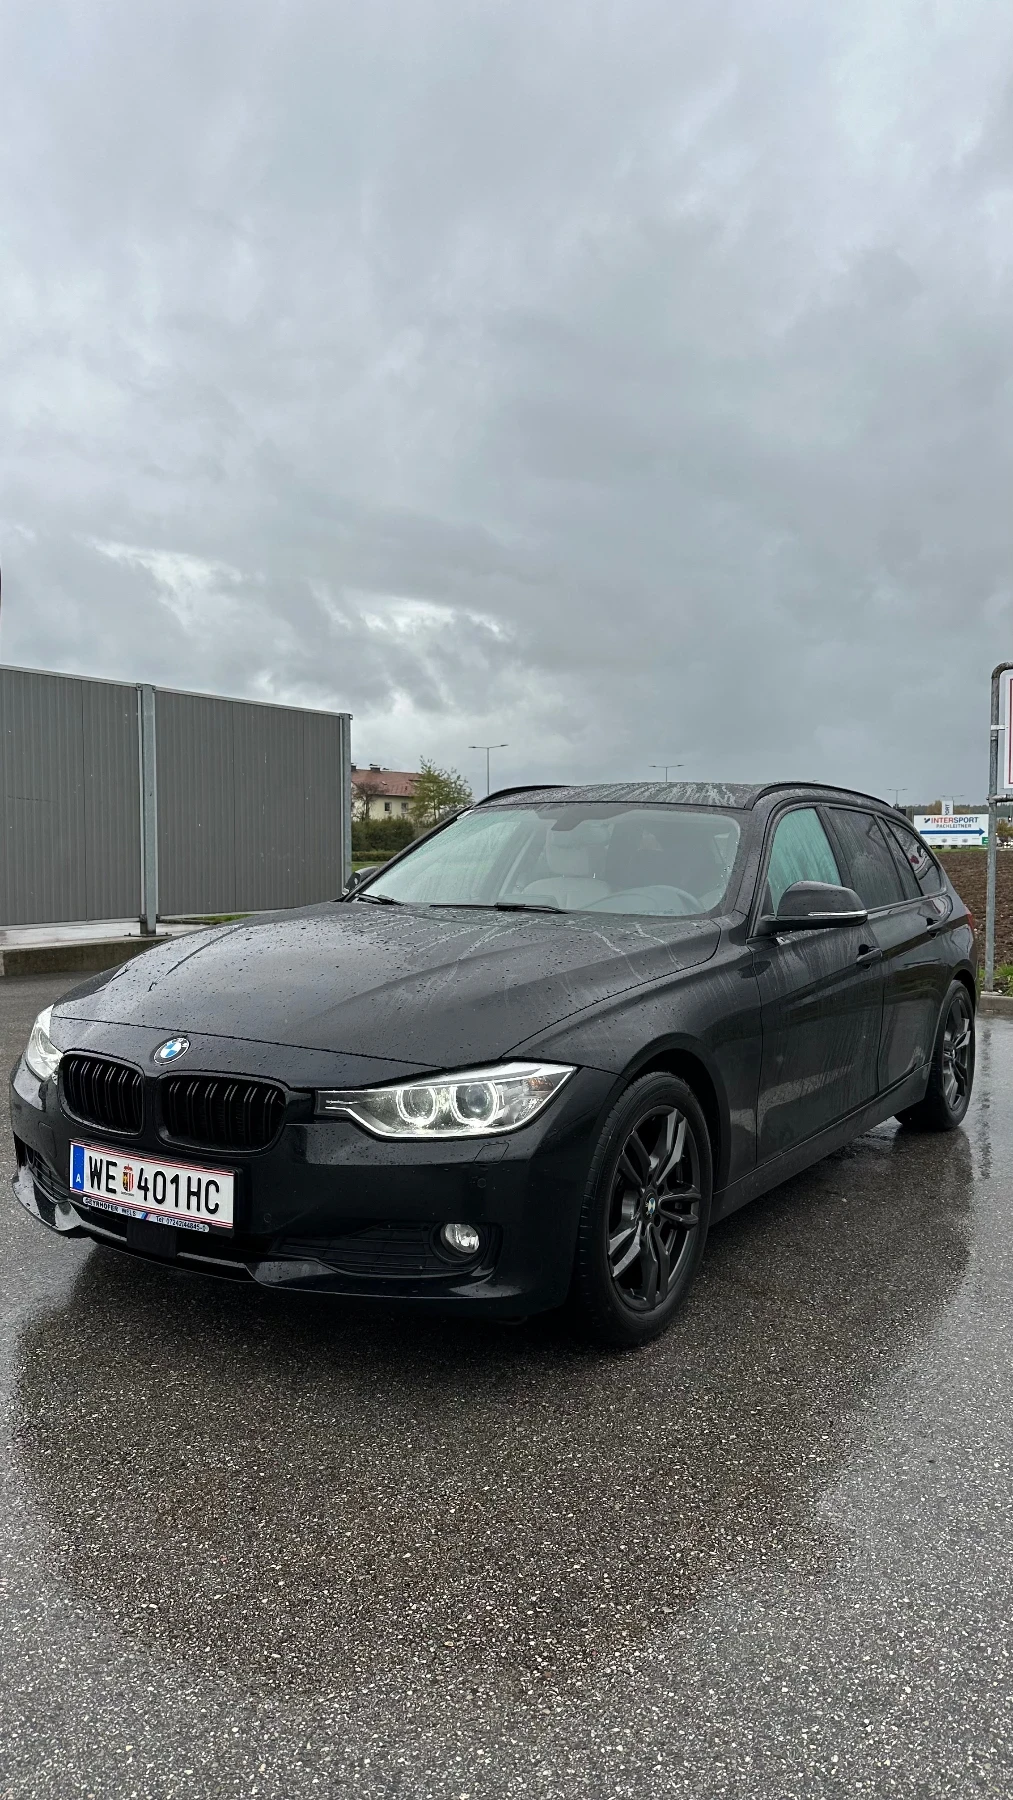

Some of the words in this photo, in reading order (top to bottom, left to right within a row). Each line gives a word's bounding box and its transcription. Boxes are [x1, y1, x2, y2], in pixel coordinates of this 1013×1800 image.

[931, 816, 979, 824] INTERSPORT
[75, 1173, 82, 1184] A
[89, 1155, 118, 1195] WE
